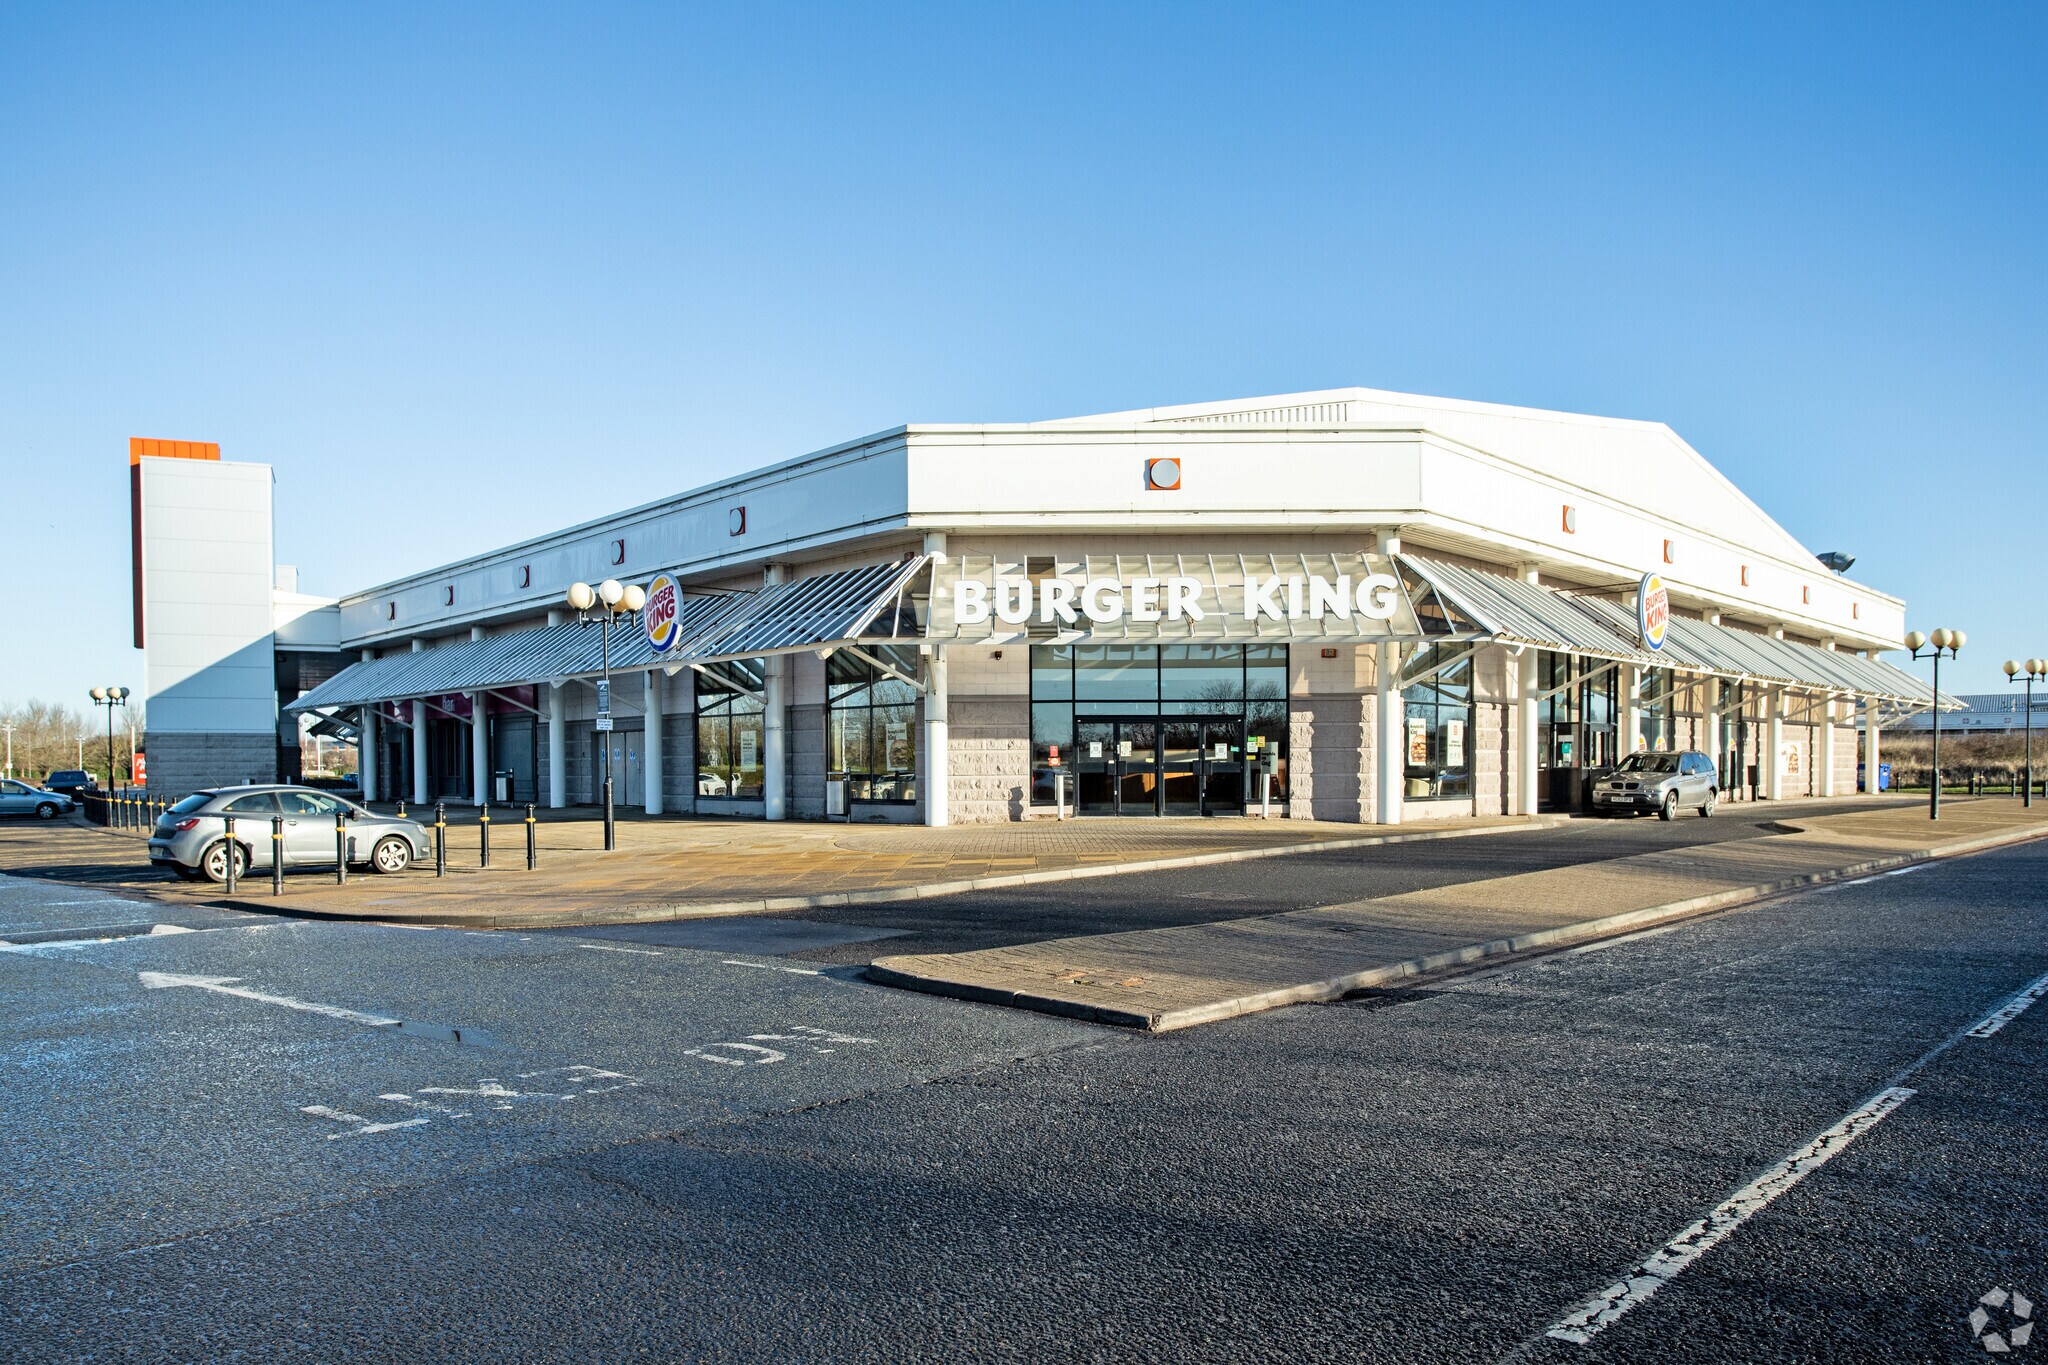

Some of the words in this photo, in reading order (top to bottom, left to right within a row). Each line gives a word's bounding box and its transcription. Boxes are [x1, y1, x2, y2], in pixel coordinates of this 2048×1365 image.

[645, 584, 674, 616] BURGER
[953, 577, 1205, 624] BURGER
[1243, 573, 1399, 622] KING
[1645, 589, 1666, 612] BURGER
[646, 598, 675, 638] KING
[1645, 603, 1667, 632] KING
